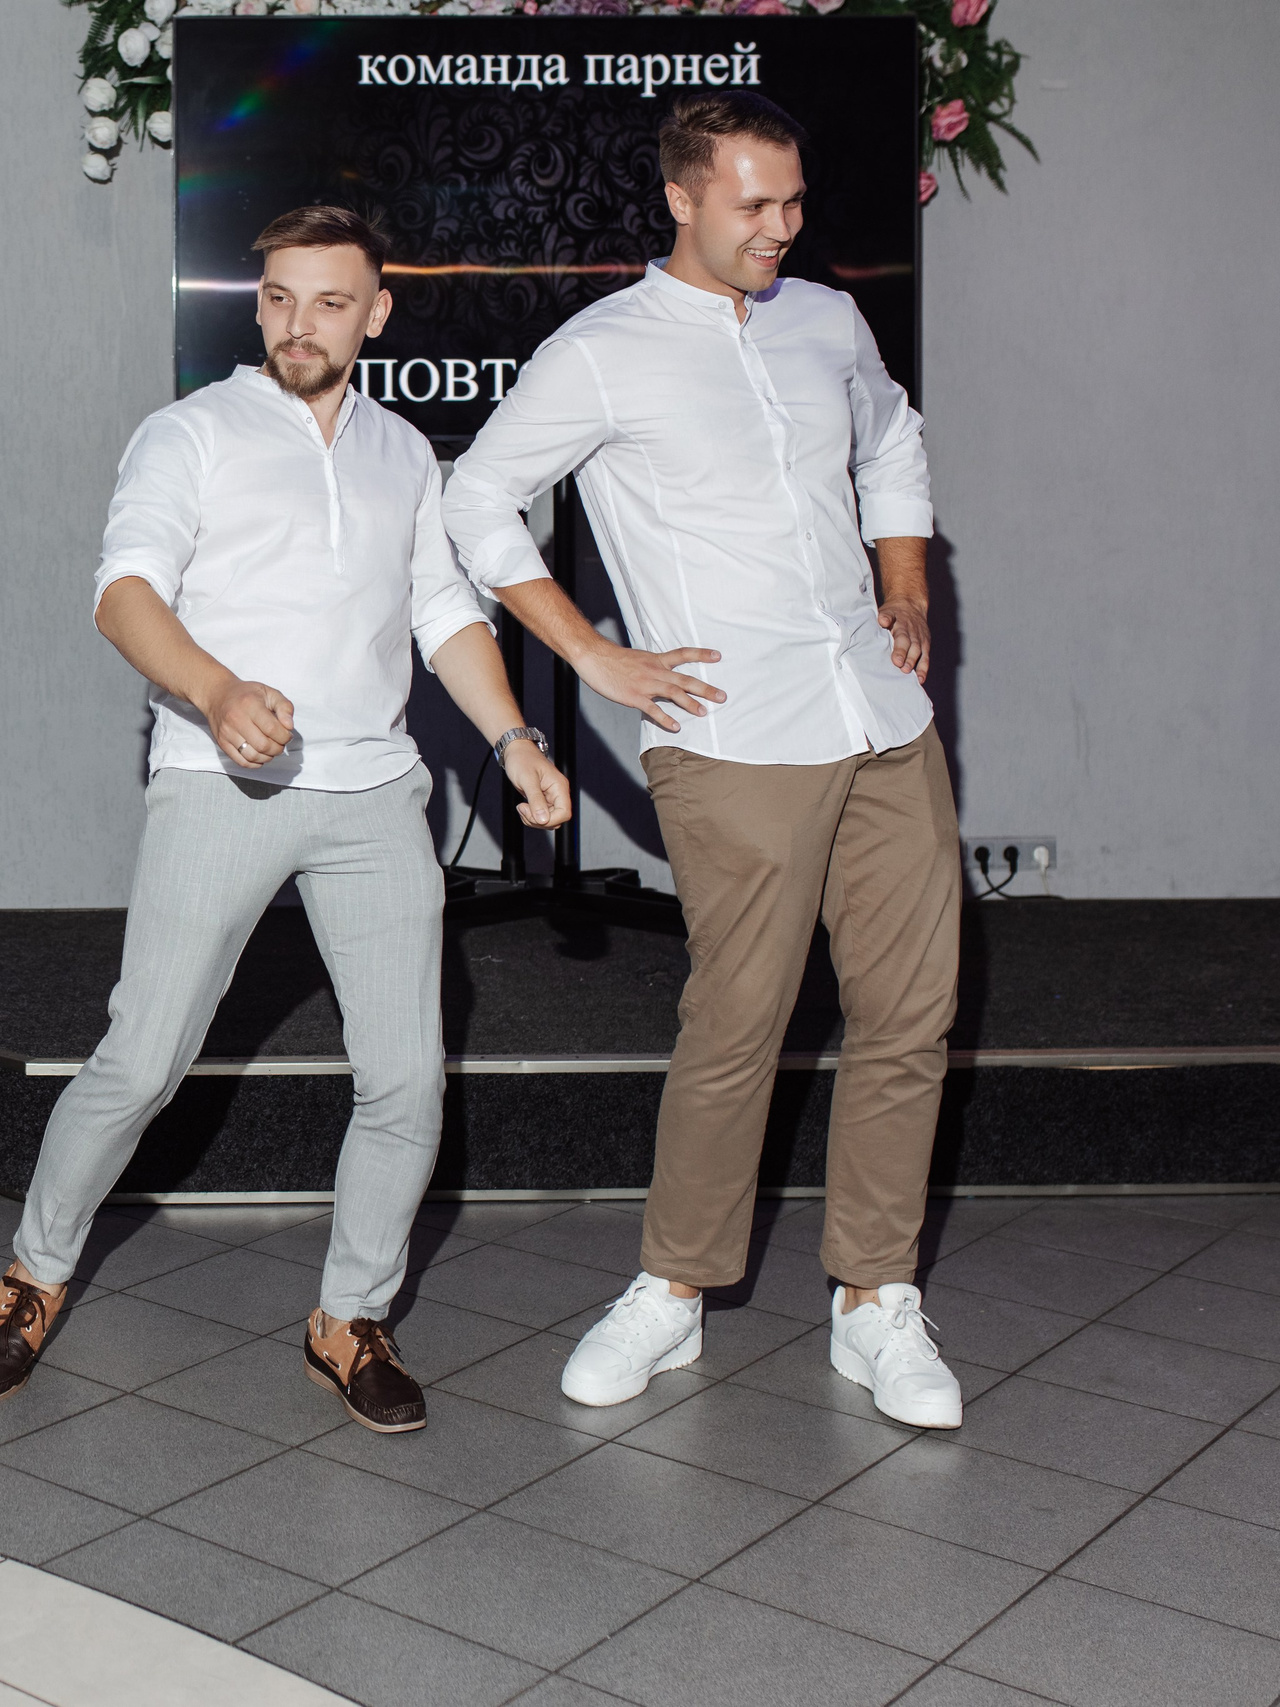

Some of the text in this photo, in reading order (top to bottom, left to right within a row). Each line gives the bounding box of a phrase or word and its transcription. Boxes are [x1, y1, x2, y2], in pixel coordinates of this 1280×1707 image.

[357, 42, 762, 98] команда парней
[356, 357, 530, 402] ПОВТ
